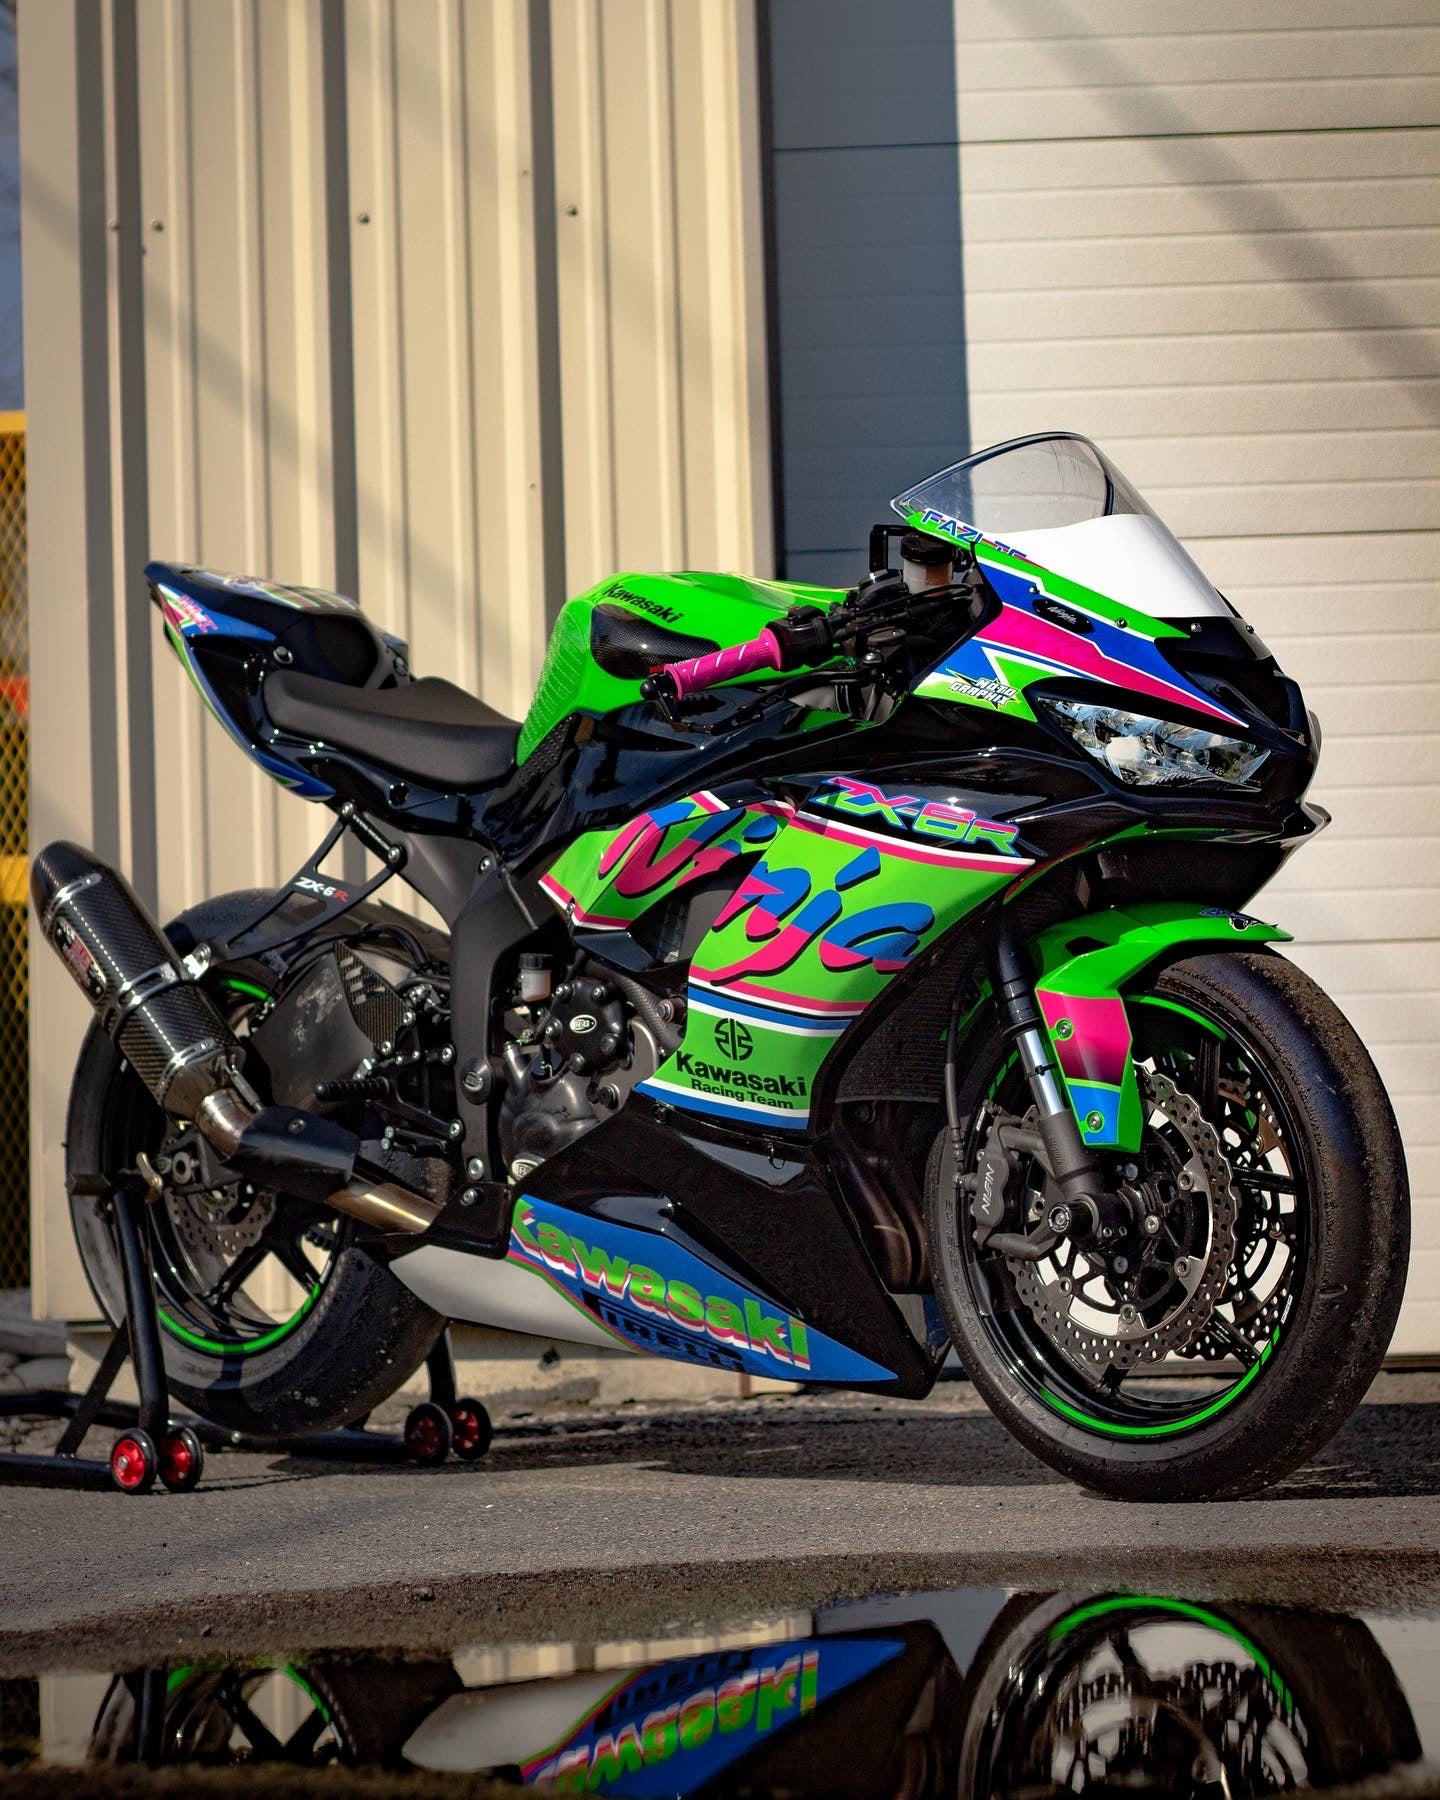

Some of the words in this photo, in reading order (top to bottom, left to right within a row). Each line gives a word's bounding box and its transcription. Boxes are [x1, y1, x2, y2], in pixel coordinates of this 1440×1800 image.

[602, 583, 685, 624] Kawasaki
[975, 679, 1019, 698] MOTO
[809, 776, 1023, 858] ZX-6R
[294, 876, 349, 903] ZX-6R
[597, 801, 937, 987] Ninja
[675, 1050, 808, 1097] Kawasaki
[691, 1078, 745, 1103] Racing
[746, 1091, 794, 1110] Team
